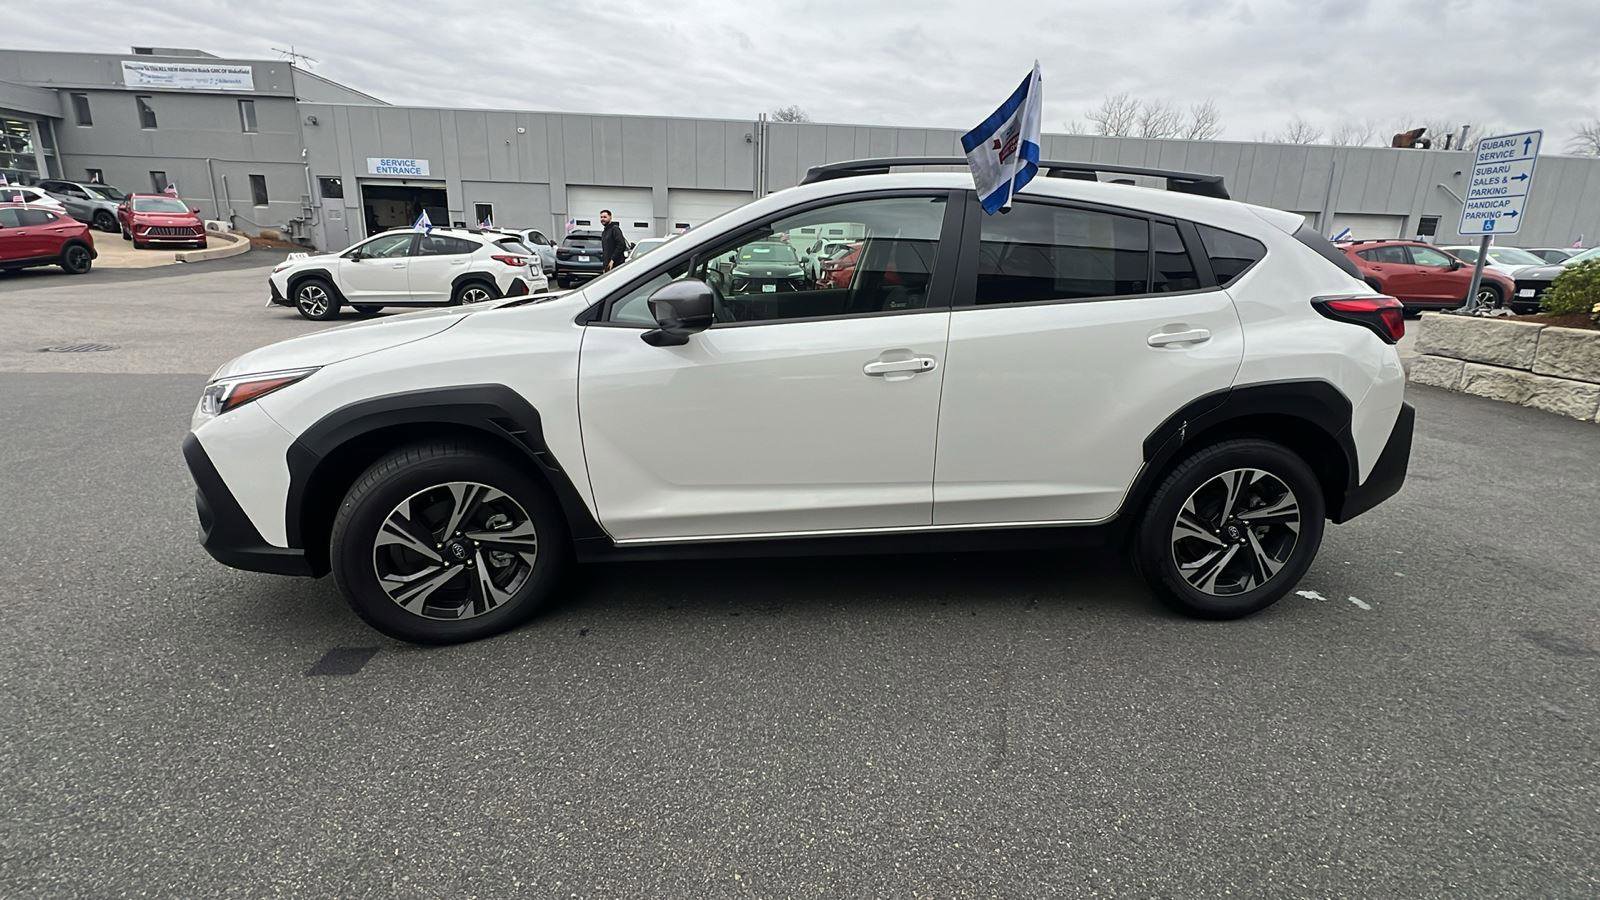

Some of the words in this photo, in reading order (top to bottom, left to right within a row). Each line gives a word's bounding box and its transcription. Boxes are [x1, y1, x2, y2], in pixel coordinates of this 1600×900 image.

[1481, 140, 1517, 150] SUBARU
[1479, 150, 1515, 160] SERVICE
[1476, 165, 1511, 176] SUBARU
[1473, 178, 1500, 186] SALES
[1471, 187, 1507, 196] PARKING
[1468, 200, 1510, 209] HANDICAP
[1465, 211, 1501, 219] PARKING
